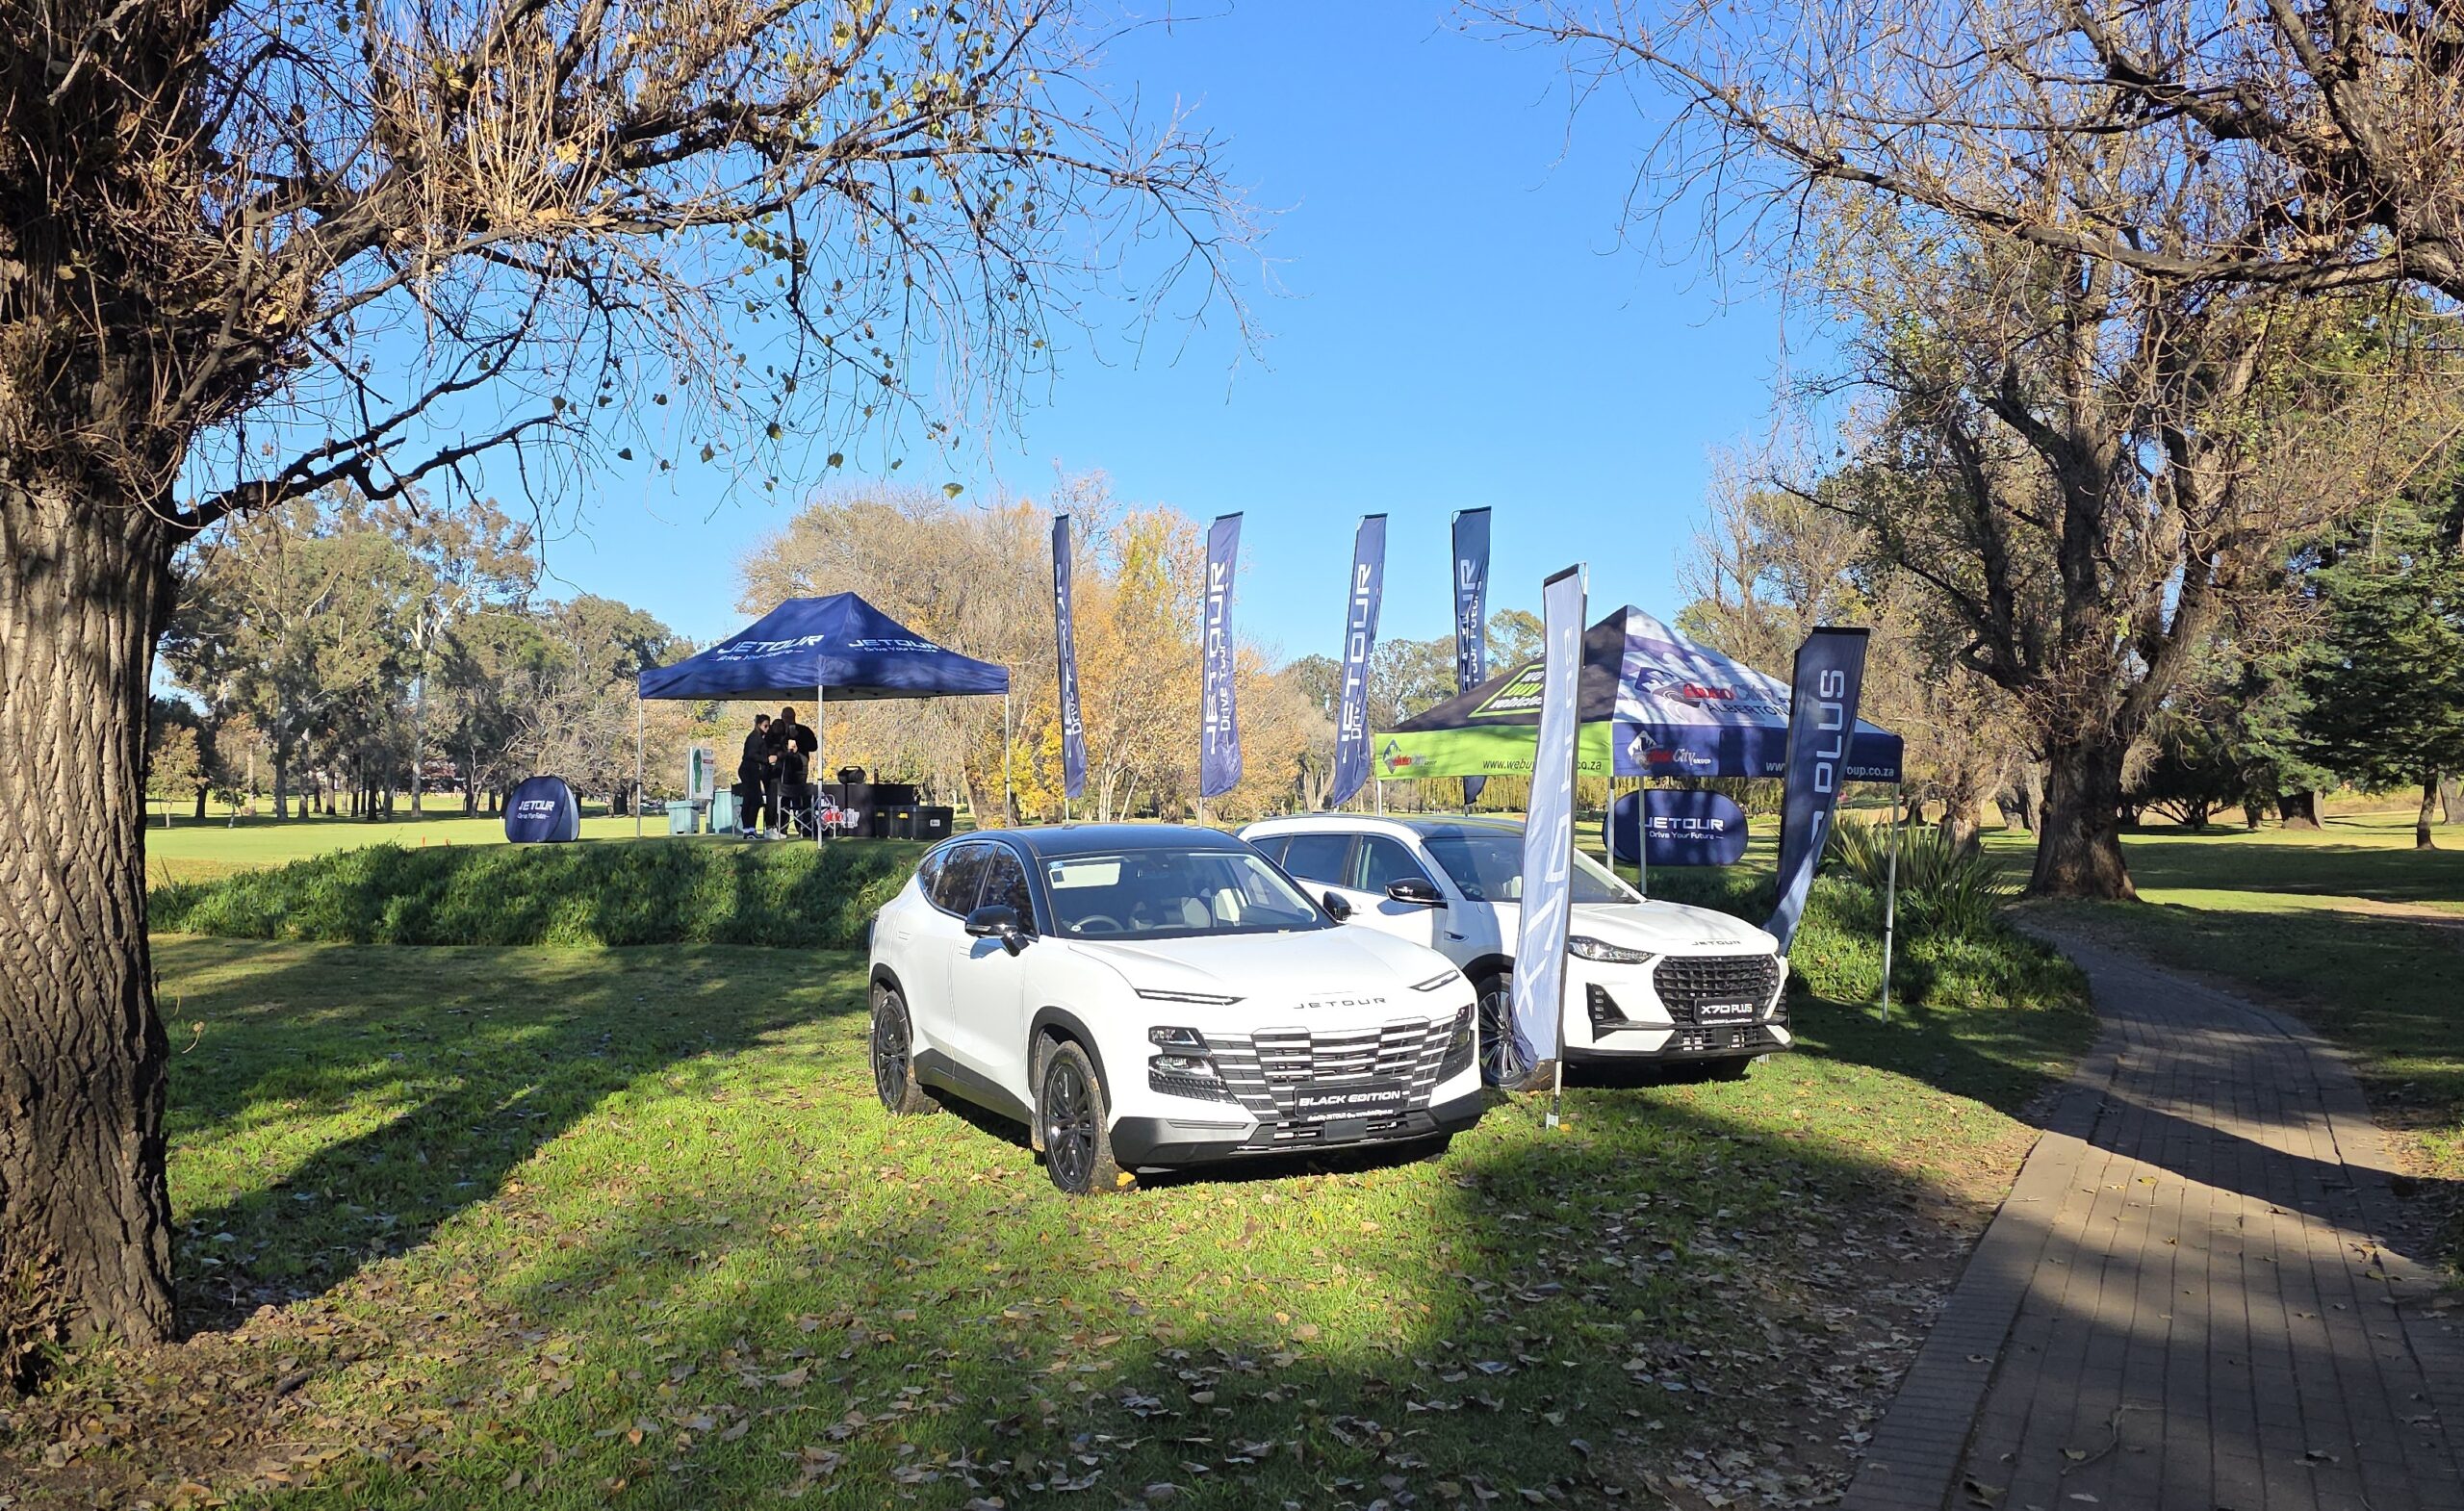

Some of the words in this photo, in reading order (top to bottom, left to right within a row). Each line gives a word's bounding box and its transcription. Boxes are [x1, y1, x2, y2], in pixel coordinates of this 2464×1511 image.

[717, 634, 825, 654] JETOUR
[848, 639, 941, 650] JETOUR
[1205, 561, 1226, 756] JETOUR
[1502, 682, 1544, 697] buy
[1220, 686, 1231, 731] Drive
[1489, 695, 1543, 709] vehicle
[1813, 669, 1845, 794] PLUS
[518, 800, 555, 811] JETOUR
[1639, 816, 1724, 832] JETOUR
[1649, 830, 1670, 839] Drive
[1671, 831, 1690, 839] Your
[1690, 832, 1714, 840] Future
[1293, 997, 1387, 1010] JETOUR
[1701, 1004, 1731, 1015] X70
[1731, 1003, 1753, 1014] PLUS
[1298, 1093, 1348, 1107] BLACK
[1348, 1089, 1401, 1104] EDITION
